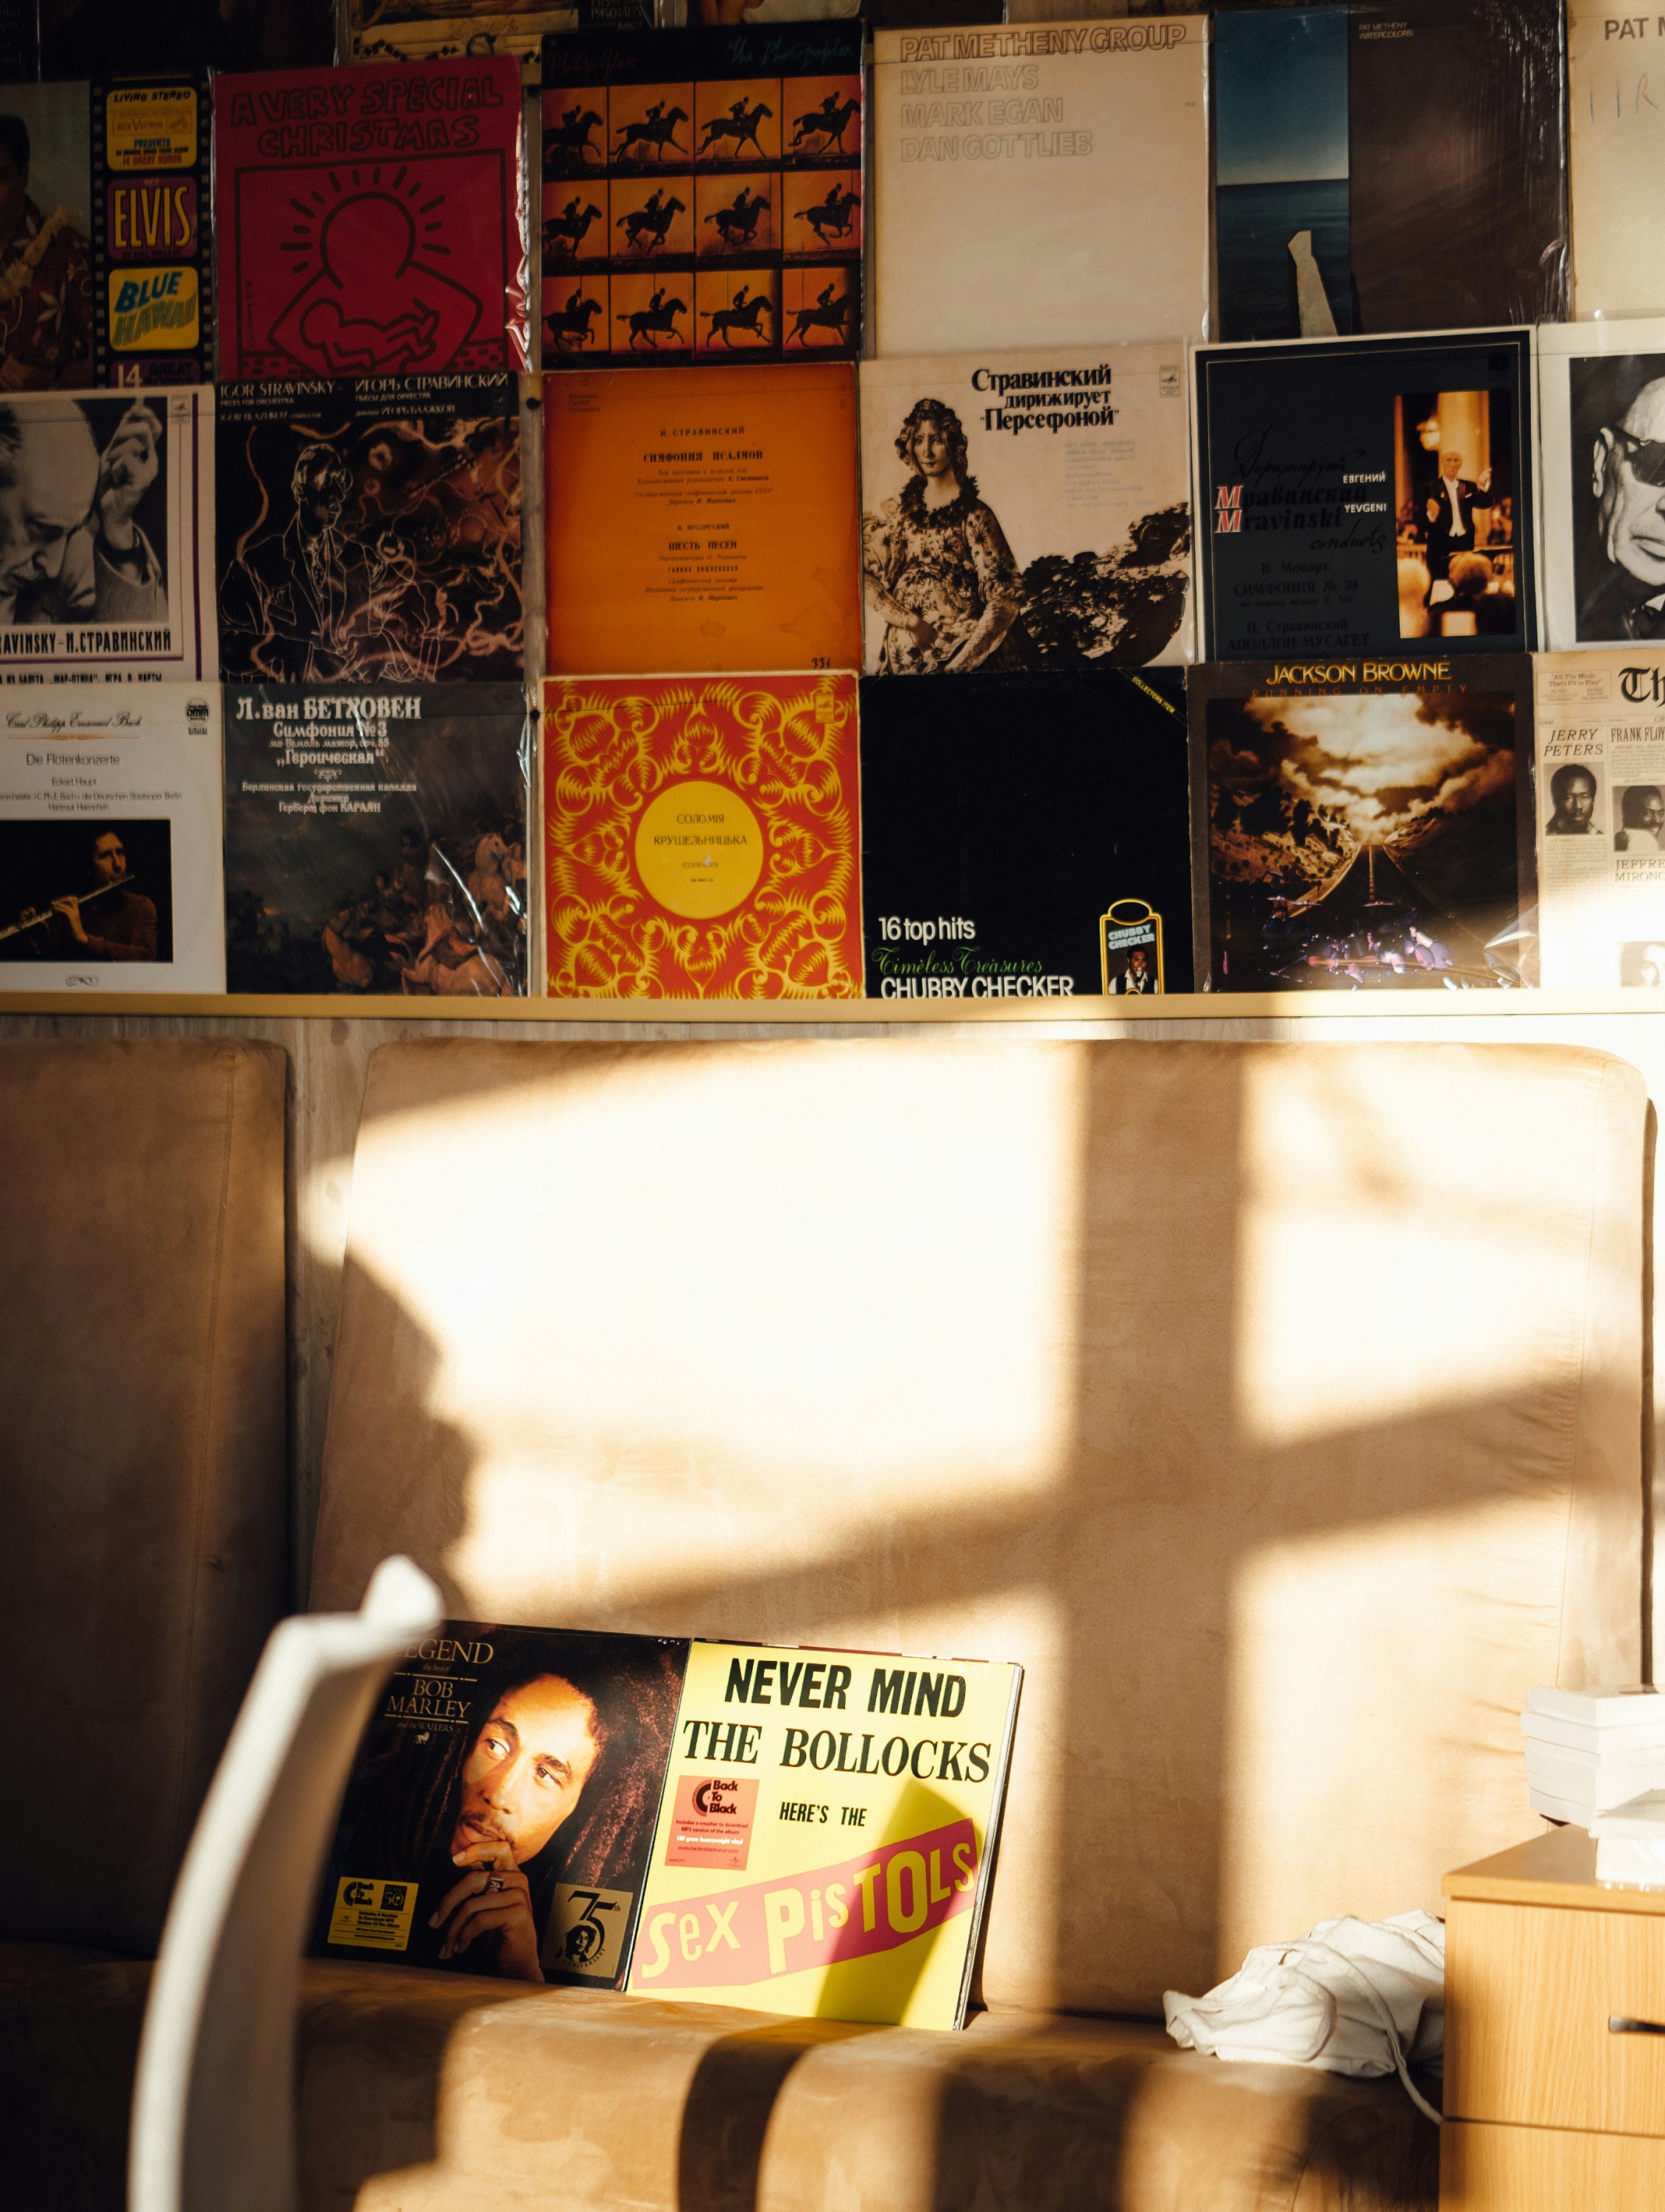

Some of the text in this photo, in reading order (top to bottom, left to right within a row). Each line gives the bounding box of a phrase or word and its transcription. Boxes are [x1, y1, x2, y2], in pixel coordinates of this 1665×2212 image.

[1605, 18, 1650, 41] PAT
[900, 24, 1187, 62] PAT METHENY GROUP
[900, 65, 1039, 95] LYLE MAYS
[113, 90, 191, 102] LIVING STEREO
[230, 74, 504, 127] A VERY SPECIAL
[900, 97, 1063, 129] MARK EGAN
[257, 114, 480, 158] CHRISTMAS
[900, 130, 1093, 164] DAN GOTTLIEB
[114, 185, 192, 248] ELVIS
[113, 270, 183, 314] BLUE
[111, 292, 197, 348] HAWAII
[118, 365, 141, 390] 14
[354, 371, 508, 393] ИГОРЬ СТРАВИНСКИЙ
[971, 364, 1112, 397] Стравинский
[220, 380, 337, 399] IGOR STRAVINSKY
[1004, 390, 1112, 410] дирижирует
[672, 425, 745, 437] СТРАВИНСКИЙ
[643, 449, 763, 463] СИМФОНИЯ ПСАЛМОВ
[1343, 469, 1387, 484] ЕВГЕНИЙ
[1214, 483, 1367, 514] Мравинский
[1344, 502, 1387, 514] YEVGENI
[1214, 505, 1342, 533] Mravinski
[669, 540, 737, 551] ШЕСТЬ ПЕСЕН
[1233, 581, 1315, 598] СИМФОНИЯ
[1266, 617, 1347, 634] Стравинский
[0, 631, 56, 654] AVINSKY
[1227, 632, 1370, 653] АПОЛЛОН МУСАГЕТ
[1266, 661, 1452, 685] JACKSON BROWNE
[304, 695, 422, 720] БЕТХОВЕН
[273, 721, 354, 741] Симфония
[1547, 728, 1599, 744] JERRY
[1610, 727, 1642, 743] FRANK
[27, 753, 43, 766] Die
[1543, 743, 1604, 757] PETERS
[340, 800, 381, 813] КАРАЯН
[676, 814, 724, 825] СОЛОМІЯ
[653, 835, 747, 847] КРУШЕЛЬНИЦЬКА
[879, 915, 976, 946] 16 top hits
[1107, 924, 1152, 942] CHUBBY
[1107, 932, 1156, 951] CHECKER
[872, 946, 1043, 976] Timeless Treasures
[880, 975, 1076, 998] CHUBBY CHECKER
[413, 1679, 454, 1698] BOB
[724, 1657, 967, 1718] NEVER MIND
[387, 1695, 472, 1718] MARLEY
[683, 1720, 992, 1783] THE BOLLOCKS
[712, 1779, 738, 1791] Back
[711, 1791, 723, 1802] To
[709, 1802, 737, 1814] Black
[779, 1802, 867, 1827] HERE'S THE
